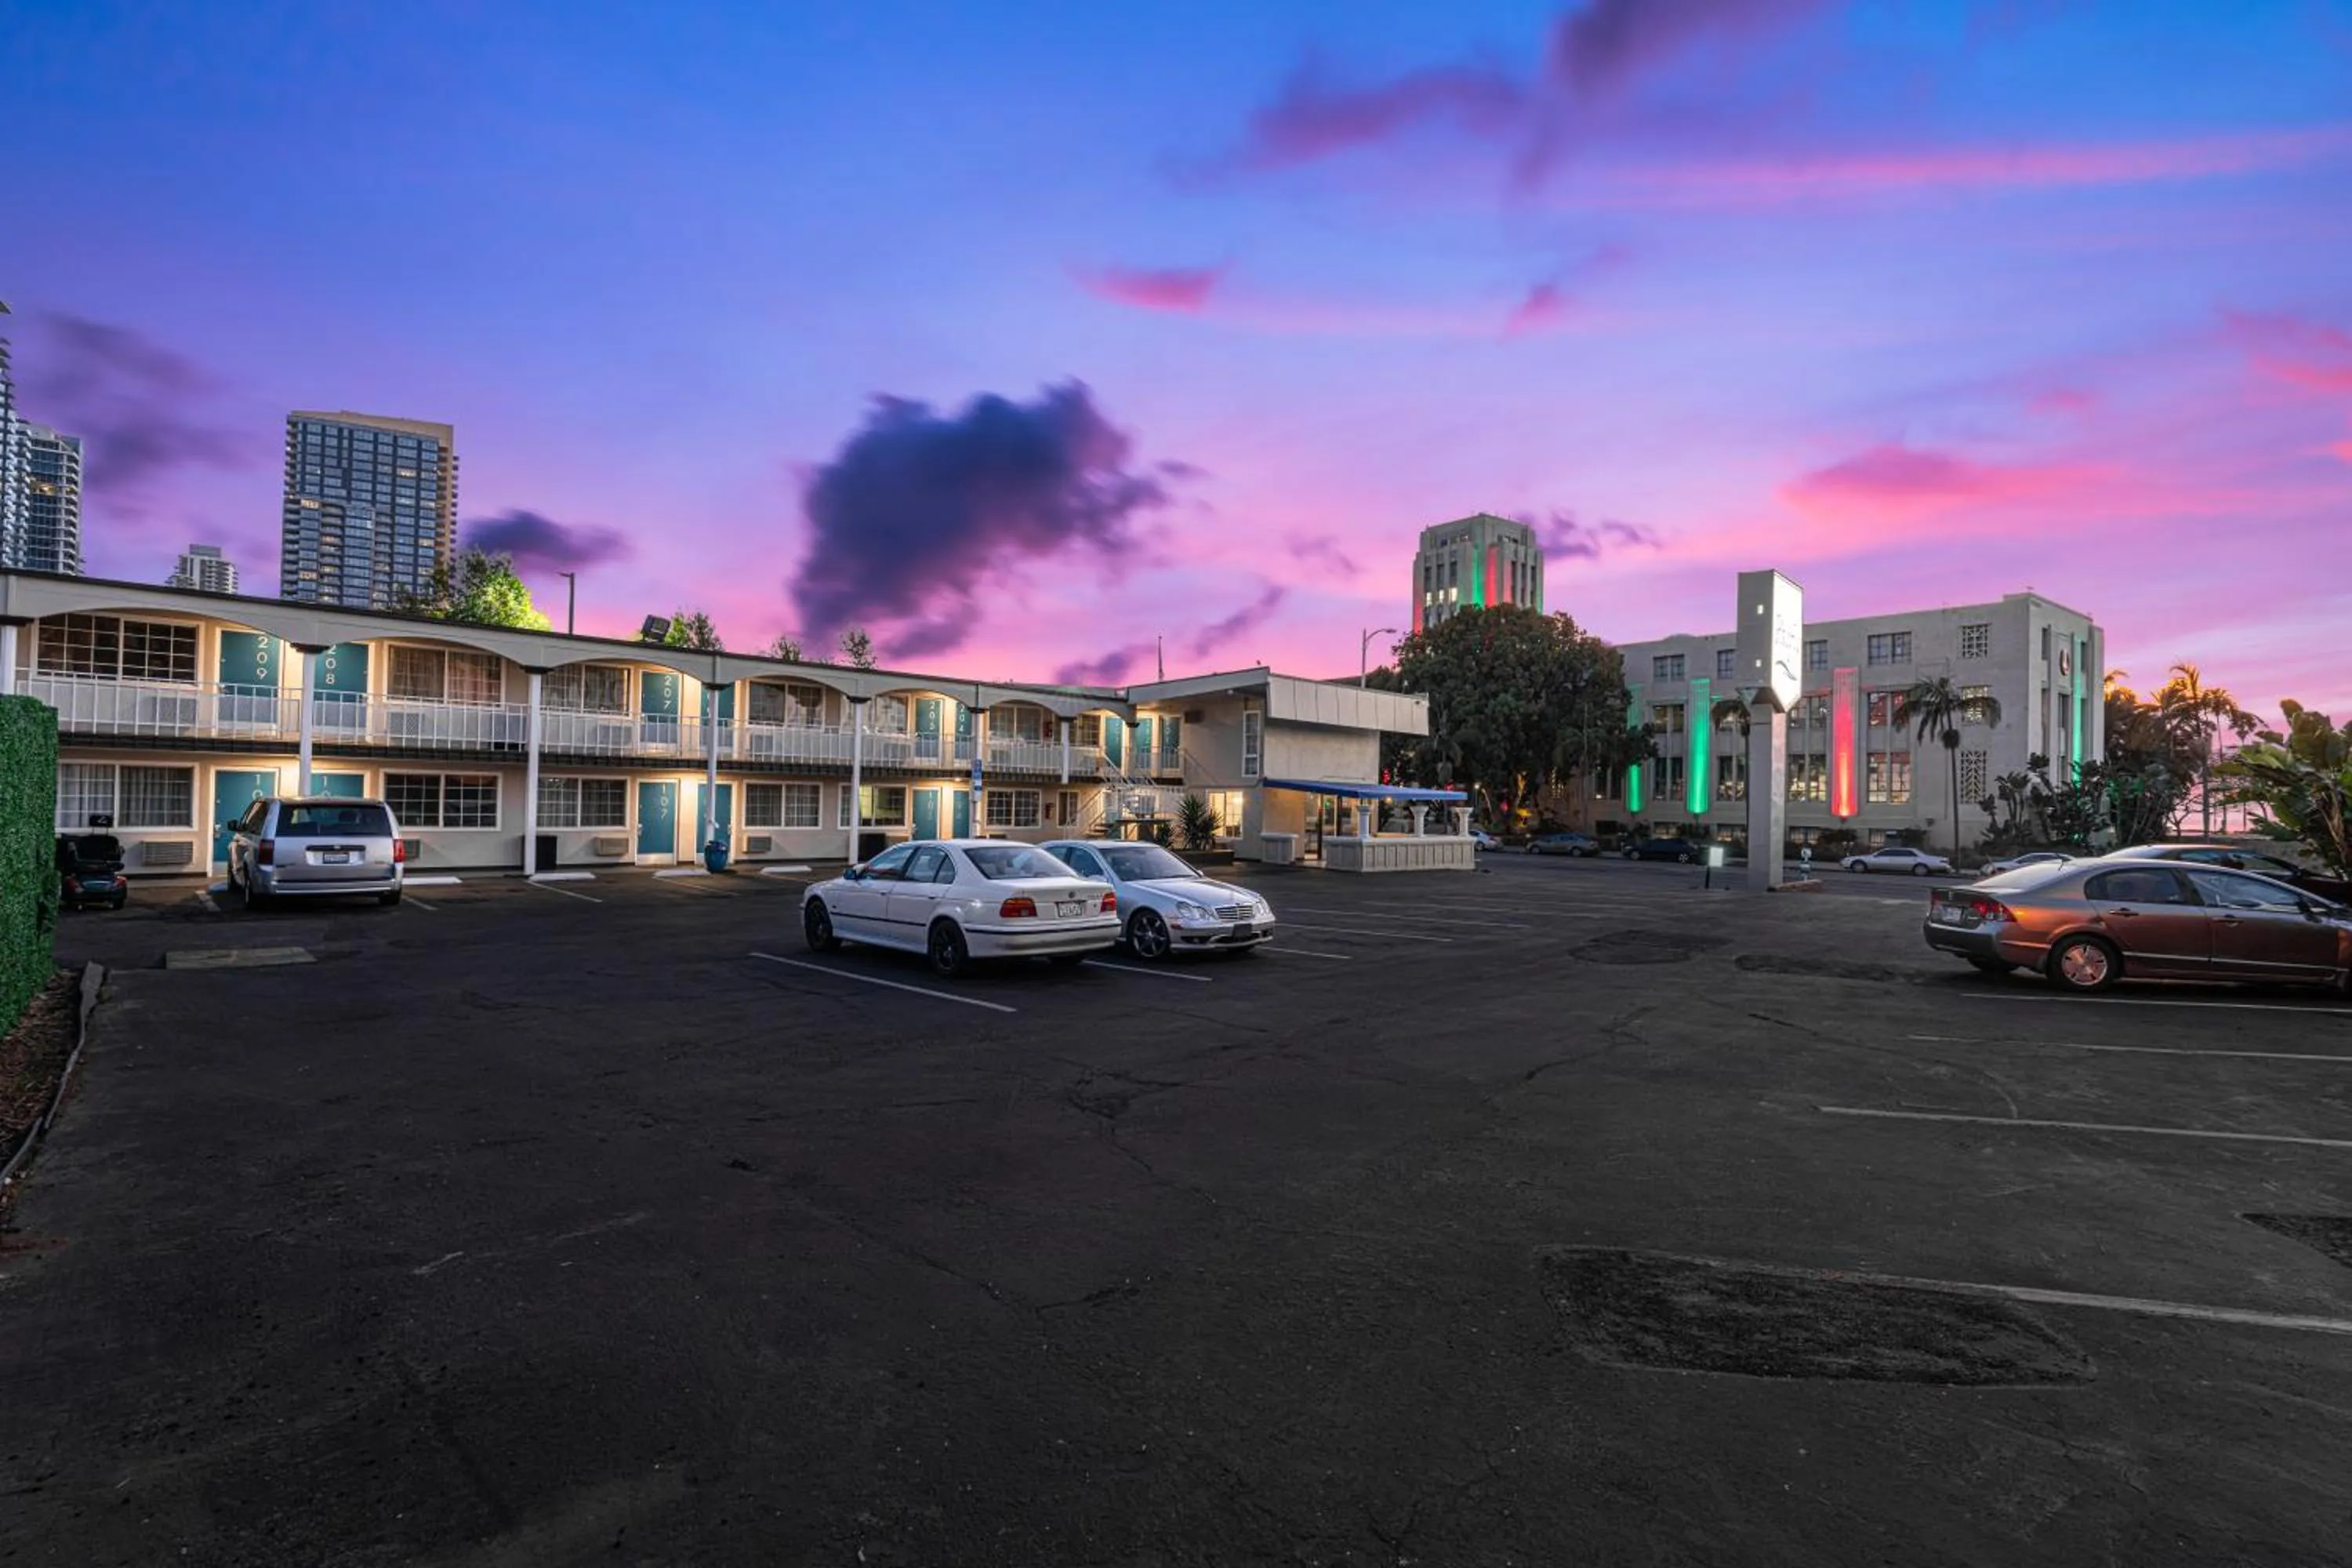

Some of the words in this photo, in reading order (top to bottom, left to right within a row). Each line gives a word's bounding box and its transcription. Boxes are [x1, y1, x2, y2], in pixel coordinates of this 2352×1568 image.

[256, 637, 268, 680] 209
[325, 644, 336, 684] 208
[663, 675, 672, 710] 207
[660, 783, 669, 818] 107
